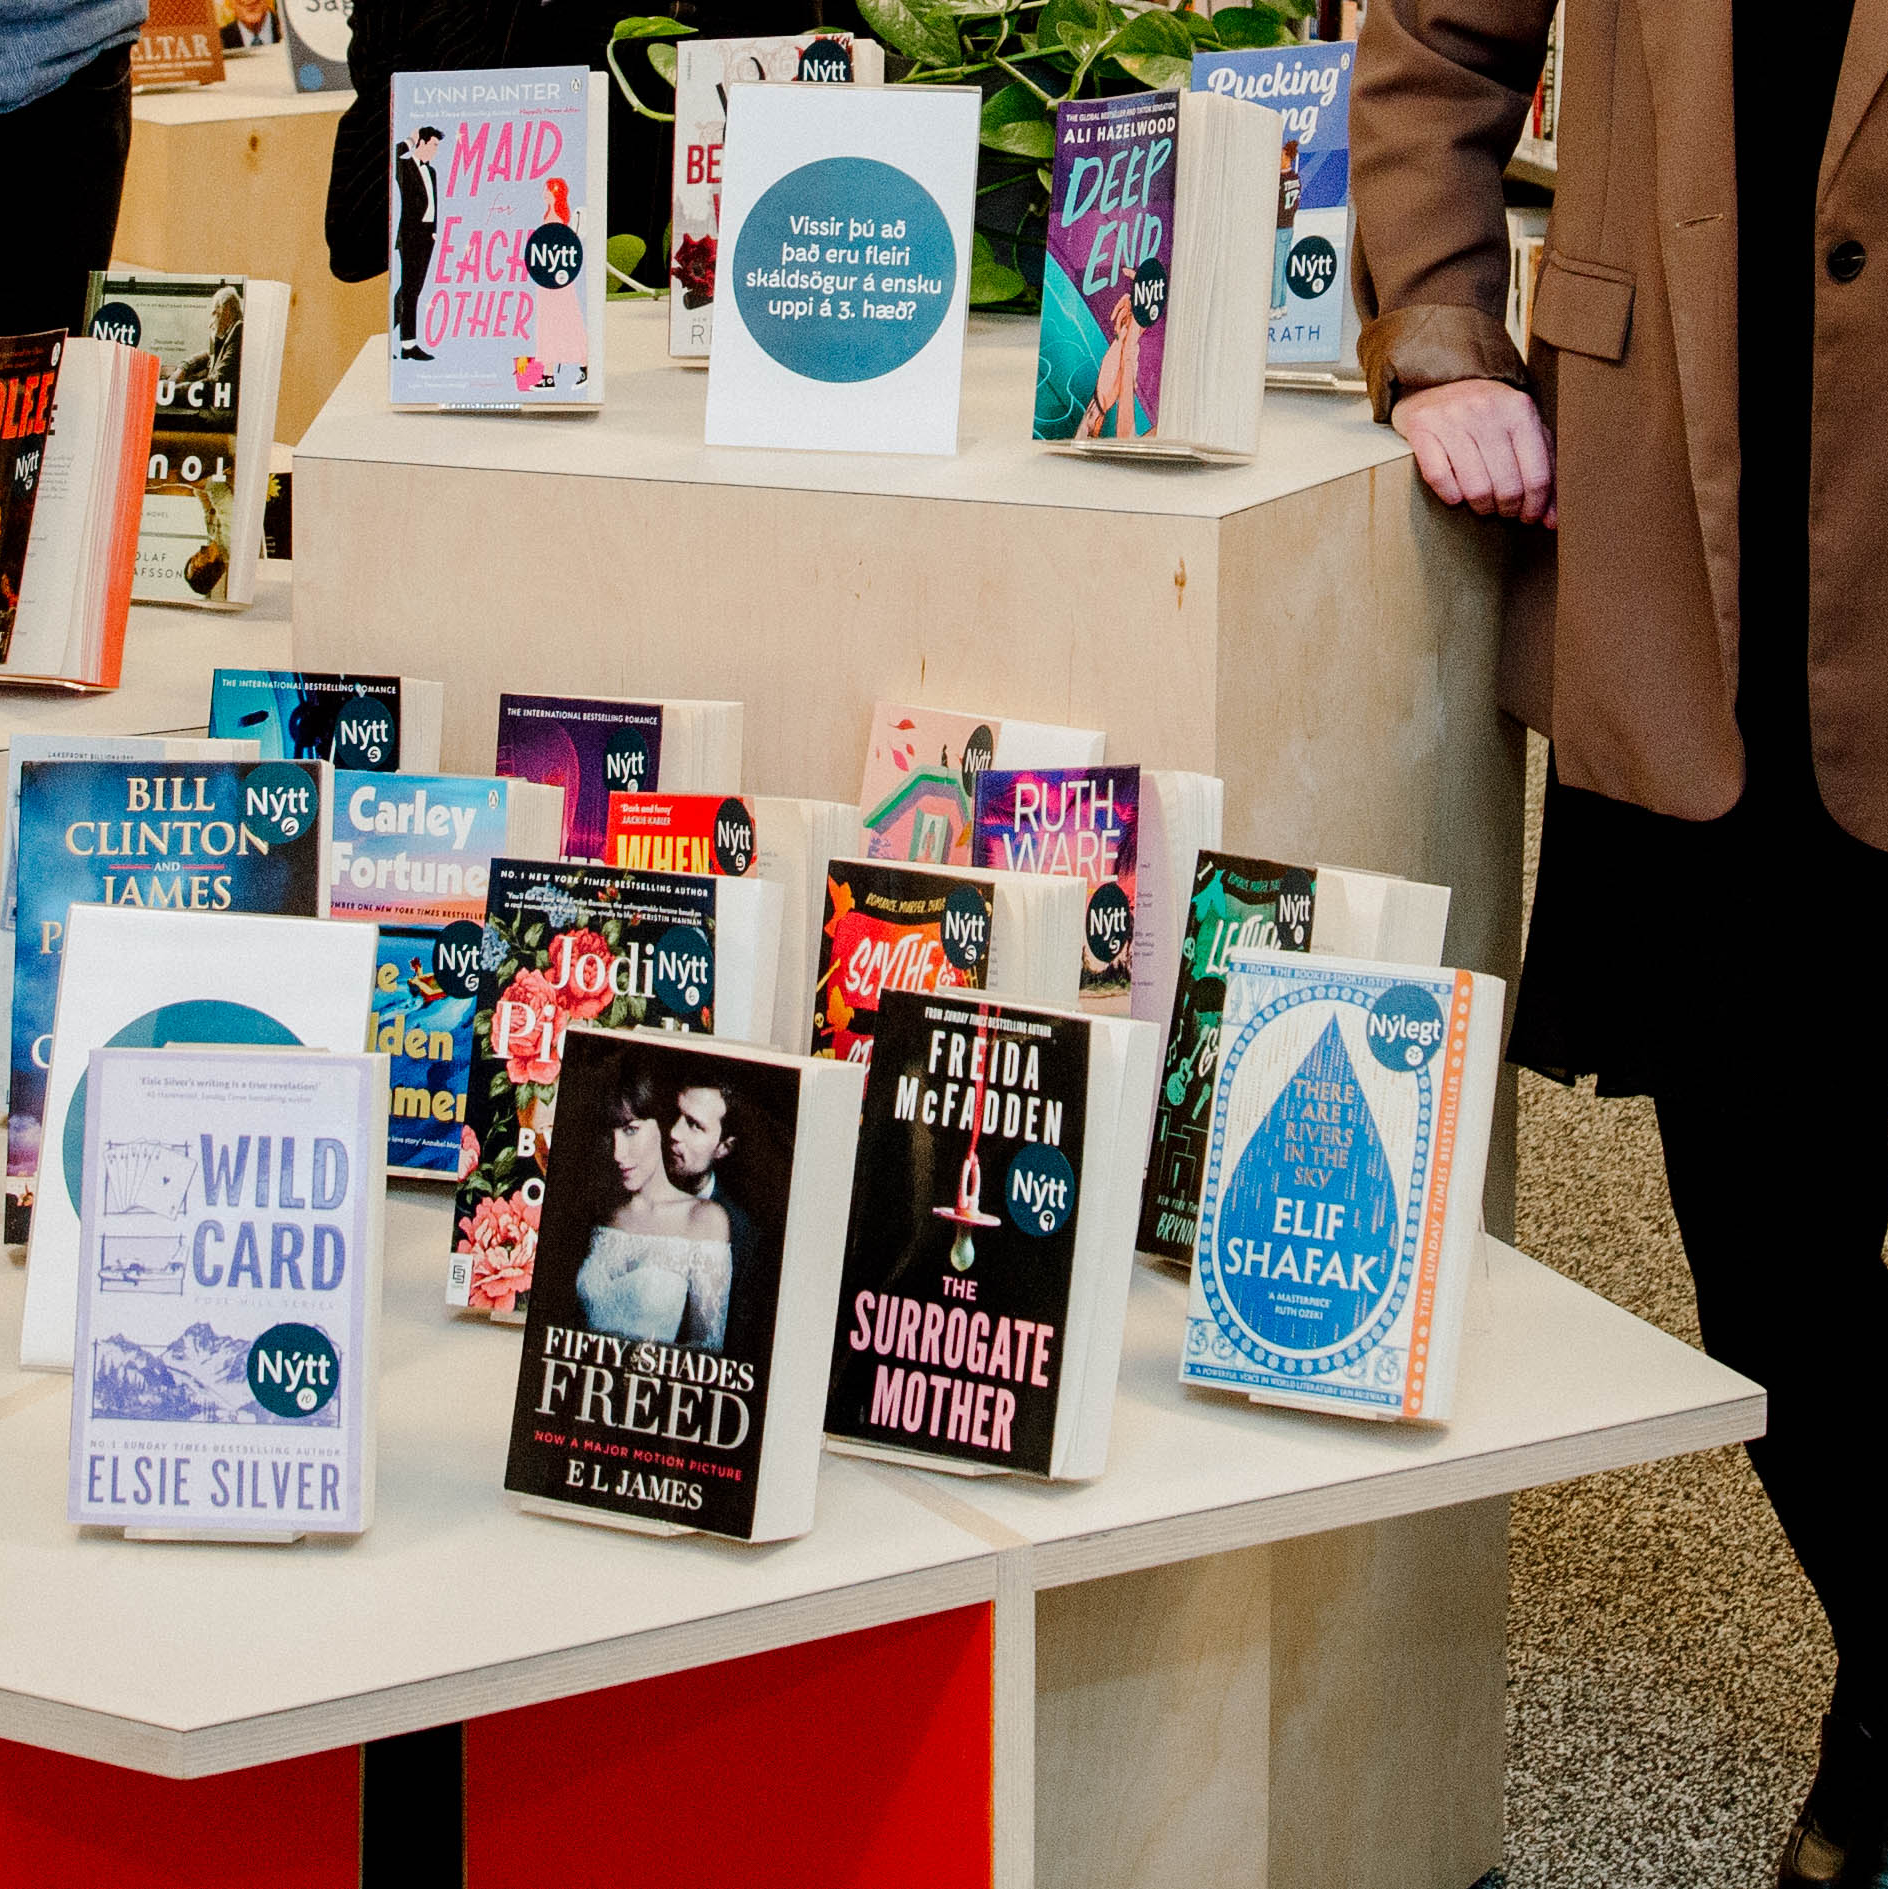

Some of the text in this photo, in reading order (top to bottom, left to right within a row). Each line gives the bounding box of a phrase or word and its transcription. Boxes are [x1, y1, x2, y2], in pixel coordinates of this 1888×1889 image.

[414, 83, 560, 104] LYNN PAINTER
[1207, 60, 1340, 107] Pucking
[1063, 116, 1176, 144] ALI HAZELWOOD
[446, 120, 563, 198] MAID
[1061, 137, 1173, 228] DEEP
[790, 216, 906, 242] Vissir þú að
[434, 216, 536, 284] EACH
[530, 244, 577, 273] Nýtt
[782, 243, 910, 266] það eru fleiri
[1082, 213, 1163, 296] END
[746, 269, 941, 295] skáldsögur á ensku
[1291, 252, 1333, 285] Nýtt
[768, 298, 916, 320] uppi á 3. hæð?
[1133, 274, 1165, 309] Nýtt
[92, 319, 138, 345] Nýtt
[424, 289, 534, 348] OTHER
[15, 450, 41, 481] Nýtt
[223, 679, 353, 692] THE INTERNATIONAL BESTSELLING
[508, 707, 658, 725] THE INTERNATIONAL BESTSELLING ROMANCE
[341, 719, 388, 751] Nýtt
[607, 751, 644, 784] Nýtt
[964, 747, 991, 773] Nýtt
[125, 777, 216, 812] BILL
[245, 786, 310, 823] Nýtt
[1013, 779, 1114, 833] RUTH
[349, 785, 477, 850] Carley
[64, 821, 270, 856] CLINTON
[616, 834, 710, 874] WHEN
[717, 819, 752, 862] Nýtt
[1003, 830, 1121, 882] WARE
[154, 862, 181, 872] AND
[332, 841, 488, 897] Fortune
[529, 872, 708, 897] NEW YORK TIMES BESTSELLING AUTHOR
[102, 875, 233, 911] JAMES
[358, 903, 440, 917] ONE NEW YORK TIMES
[944, 910, 984, 947] Nýtt
[1090, 907, 1127, 945] Nýtt
[1279, 894, 1311, 930] Nýtt
[551, 935, 656, 998] Jodi
[658, 951, 708, 990] Nýtt
[1245, 964, 1393, 987] FROM THE BOOKER-SHORTLISTED
[925, 1006, 1052, 1038] FROM SUNDAY BESTSELLING AUTHOR
[1369, 1012, 1442, 1045] Nýlegt
[928, 1030, 1039, 1091] FREIDA
[163, 1078, 229, 1089] Silver's writing
[1294, 1078, 1355, 1104] THERE
[894, 1075, 1063, 1146] McFADDEN
[1300, 1099, 1341, 1124] ARE
[1283, 1122, 1354, 1148] RIVERS
[200, 1134, 350, 1211] WILD
[1283, 1145, 1348, 1170] IN THE
[1012, 1167, 1068, 1213] Nýtt
[1294, 1166, 1333, 1190] SKY
[1419, 1074, 1462, 1317] THE SUNDAY TIMES BESTSELLER
[1156, 1211, 1197, 1246] BRYNN
[1272, 1196, 1345, 1241] ELIF
[192, 1218, 346, 1292] CARD
[1224, 1237, 1379, 1294] SHAFAK
[942, 1275, 979, 1301] THE
[1274, 1306, 1323, 1320] RUTH OZEKI
[849, 1289, 1056, 1388] SURROGATE
[257, 1349, 330, 1392] Nýtt
[545, 1326, 754, 1393] FIFTY SHADES
[535, 1357, 750, 1452] FREED
[870, 1363, 1016, 1453] MOTHER
[124, 1441, 341, 1457] SUNDAY TIMES BESTSELLING AUTHOR
[534, 1429, 743, 1482] NOW MAJOR MOTION PICTURE
[88, 1454, 340, 1511] ELSIE SILVER
[566, 1459, 703, 1511] E L JAMES
